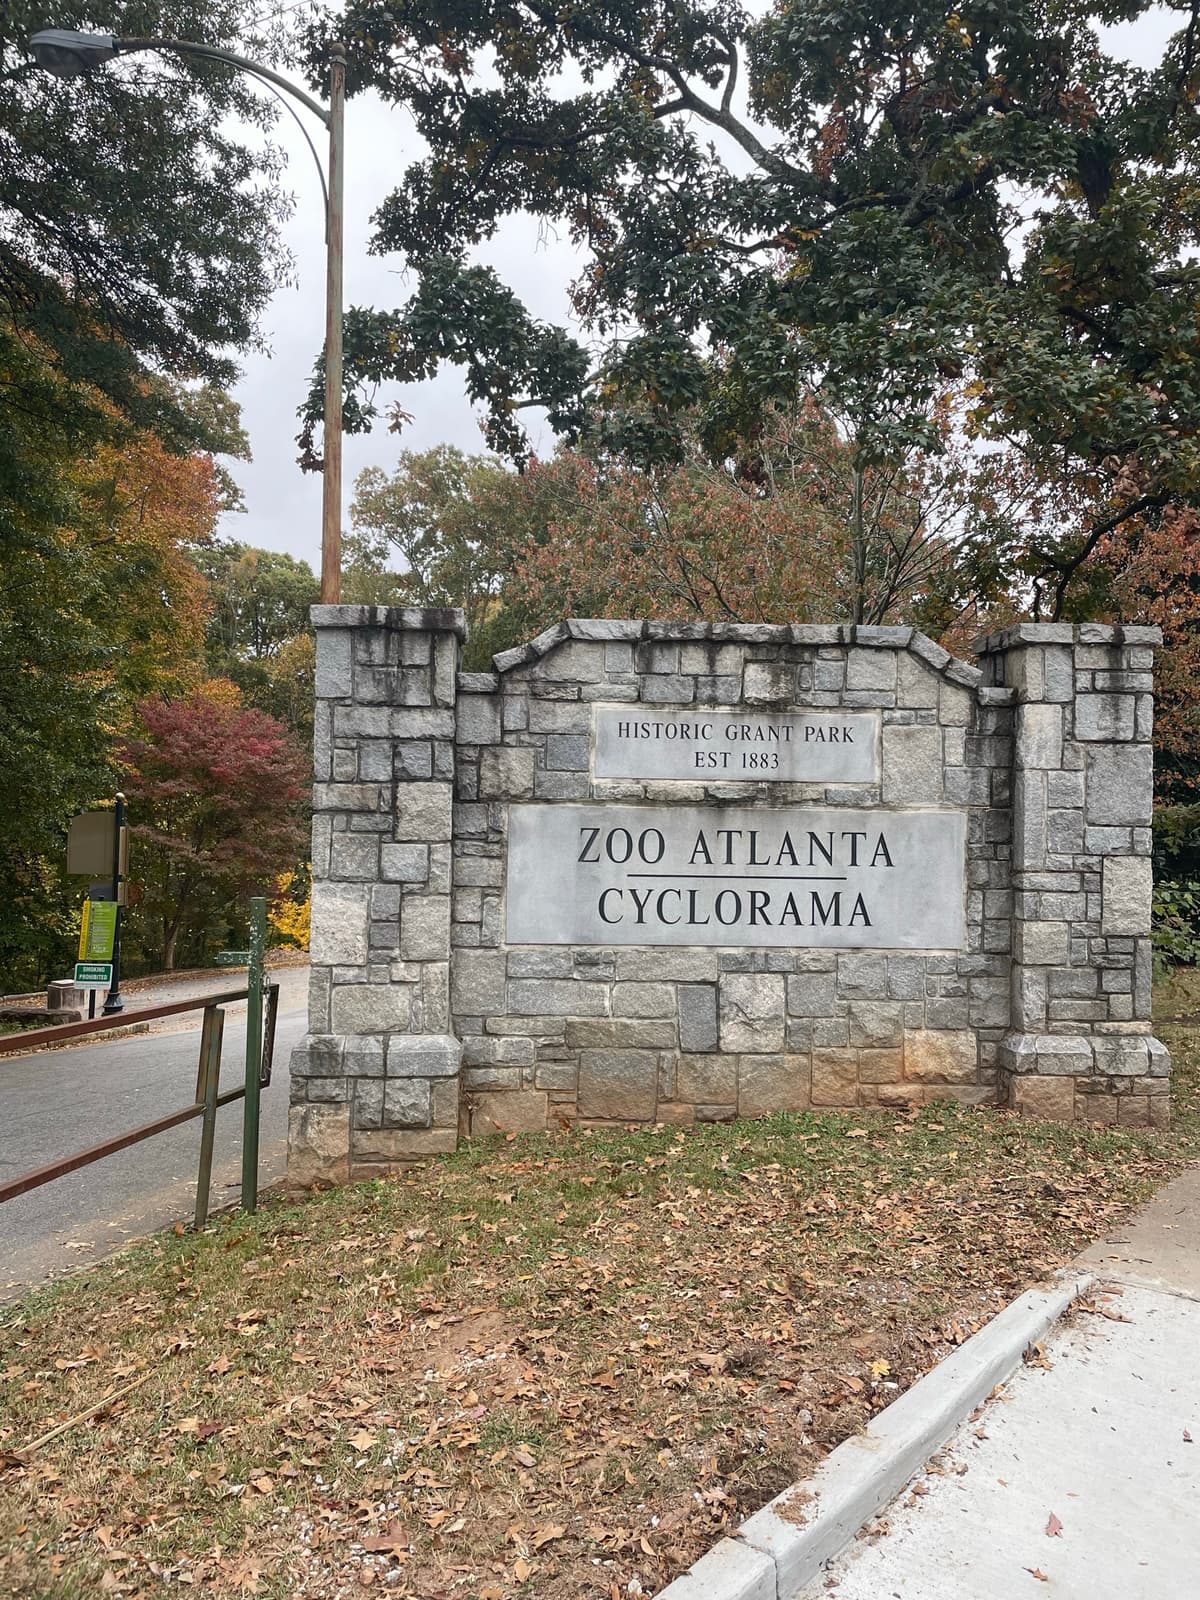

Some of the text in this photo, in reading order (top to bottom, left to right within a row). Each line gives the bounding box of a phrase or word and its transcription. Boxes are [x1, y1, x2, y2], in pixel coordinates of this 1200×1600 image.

[618, 721, 855, 743] HISTORIC GRANT PARK
[694, 751, 780, 770] EST 1883
[577, 827, 895, 867] ZOO ATLANTA
[598, 887, 874, 927] CYCLORAMA
